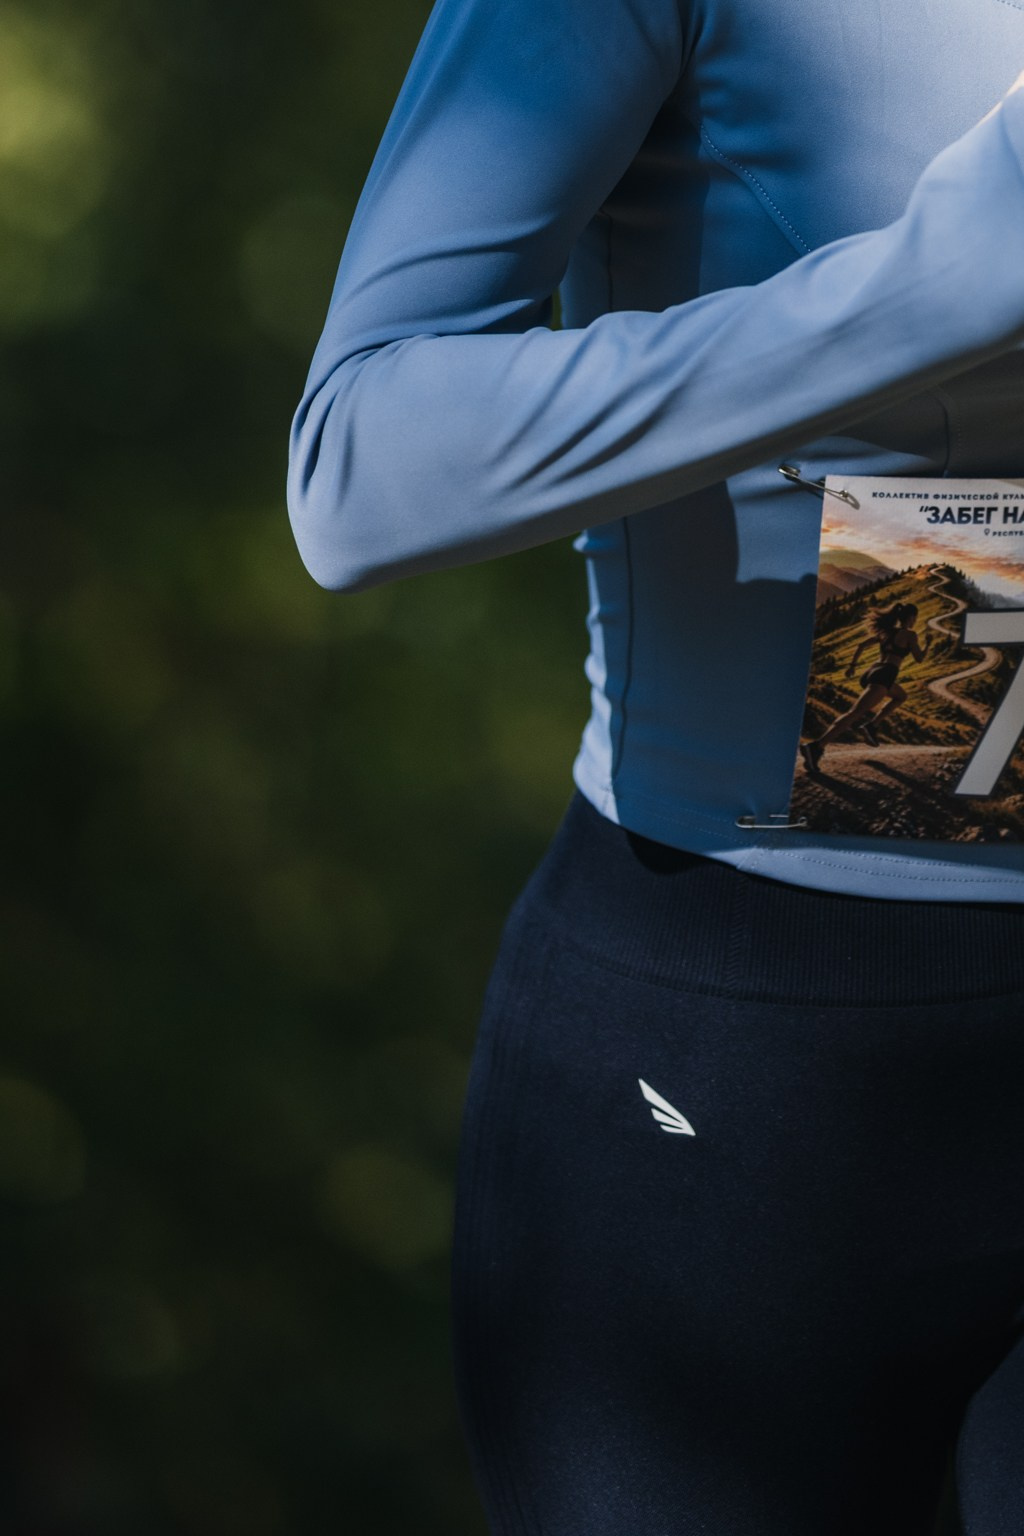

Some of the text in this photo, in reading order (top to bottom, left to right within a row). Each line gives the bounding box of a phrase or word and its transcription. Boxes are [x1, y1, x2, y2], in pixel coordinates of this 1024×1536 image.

[872, 491, 930, 499] КОЛЛЕКТИВ
[932, 492, 1000, 501] ФИЗИЧЕСКОЙ
[919, 505, 999, 525] "ЗАБЕГ
